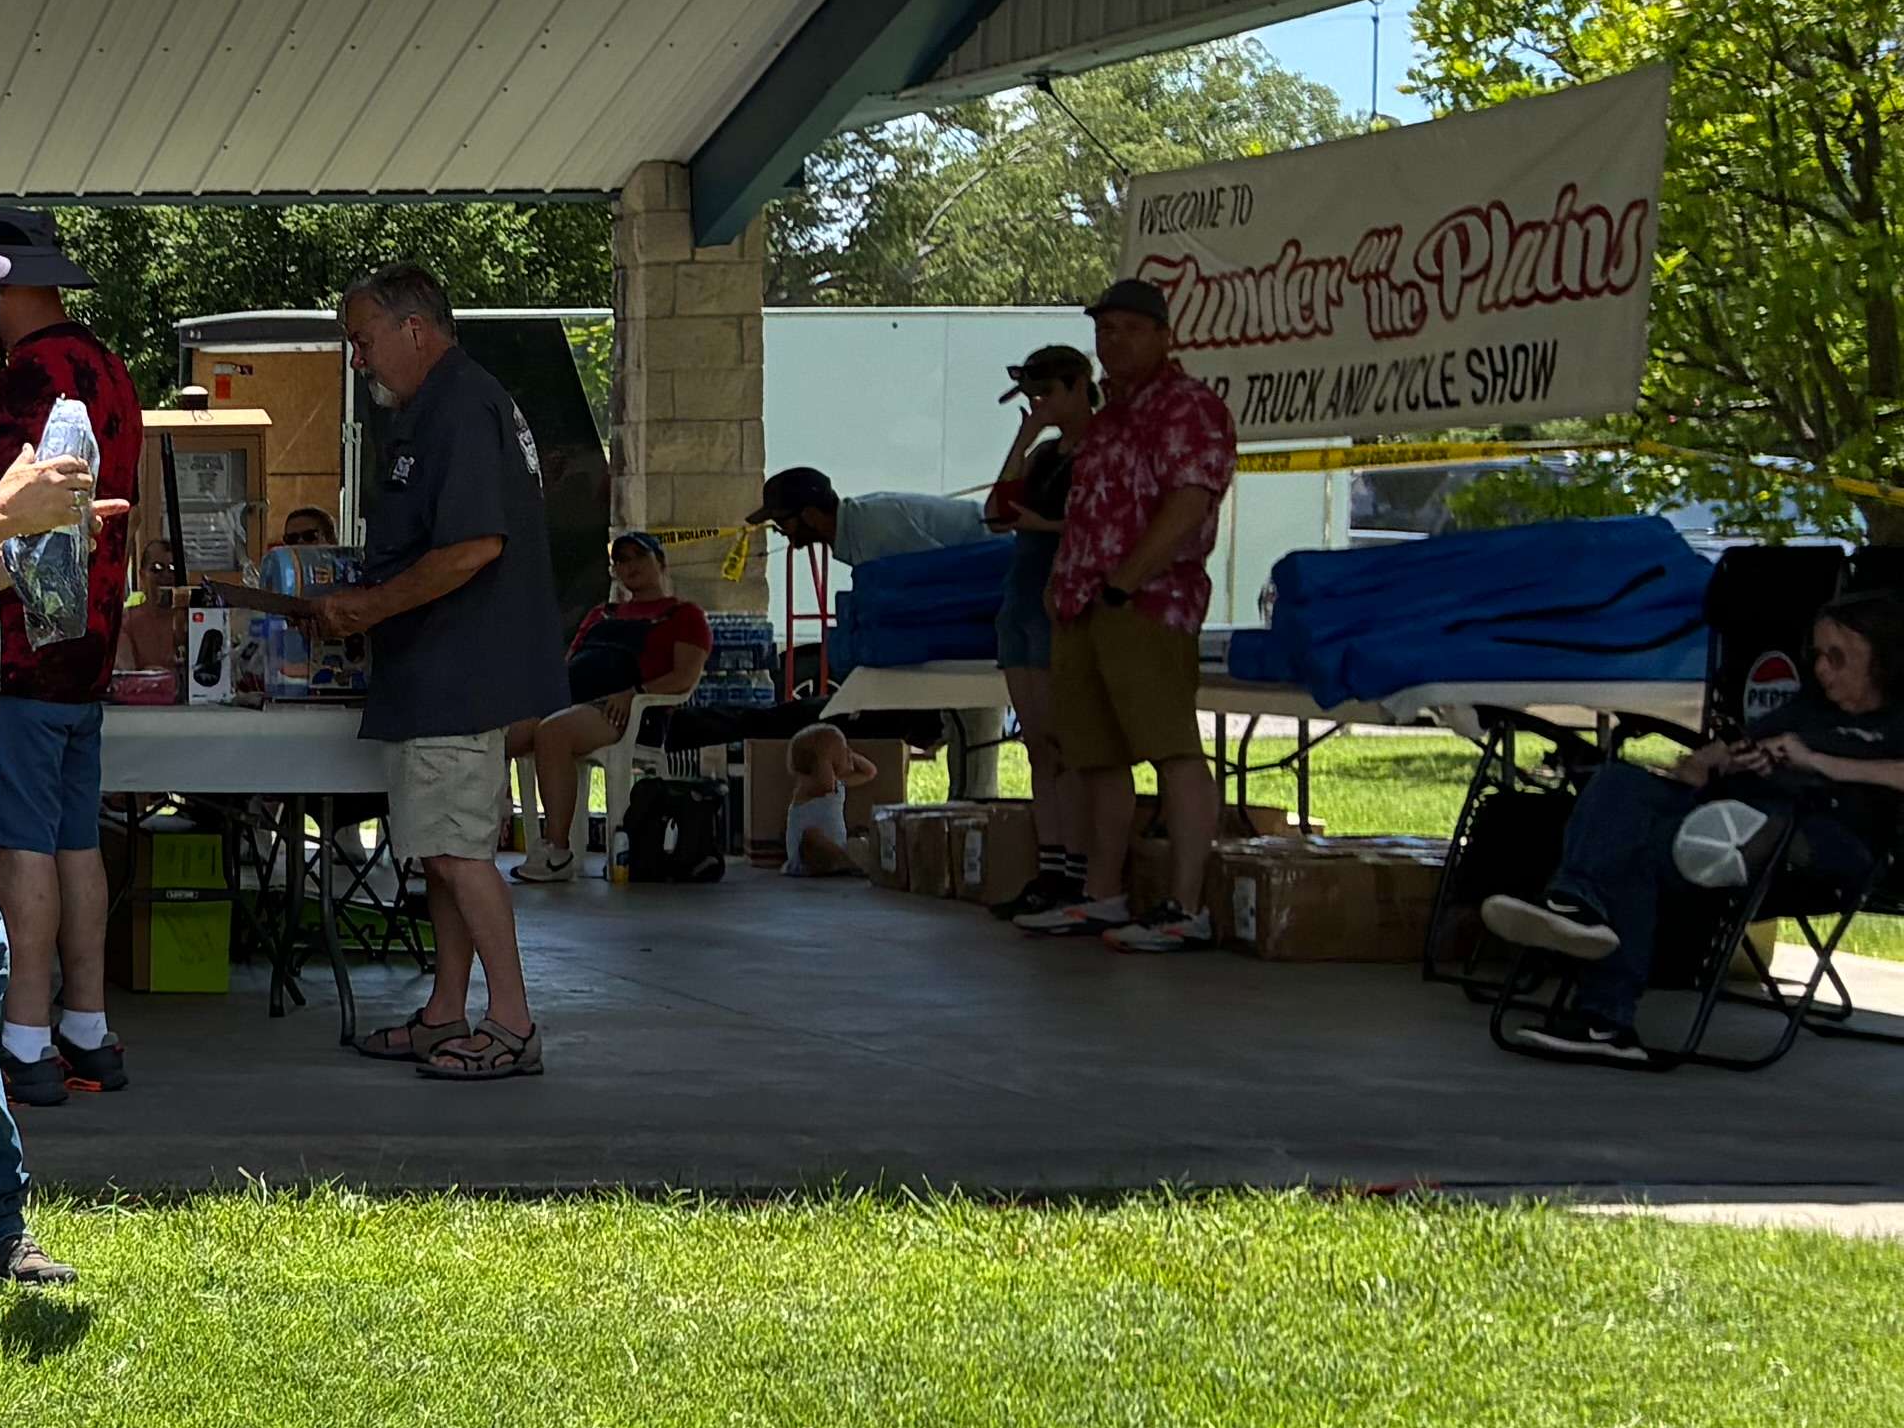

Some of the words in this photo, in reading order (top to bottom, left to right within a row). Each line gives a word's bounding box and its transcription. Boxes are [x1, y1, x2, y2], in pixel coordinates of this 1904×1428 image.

[1139, 186, 1227, 236] WELCOME
[1231, 183, 1254, 227] TO
[1346, 224, 1404, 284] on
[1413, 182, 1649, 321] Plains
[1136, 238, 1348, 351] Thunder
[1363, 274, 1428, 341] the
[1239, 368, 1325, 426] TRUCK
[1319, 363, 1378, 419] AND
[1374, 350, 1461, 413] CYCLE
[1465, 339, 1559, 406] SHOW
